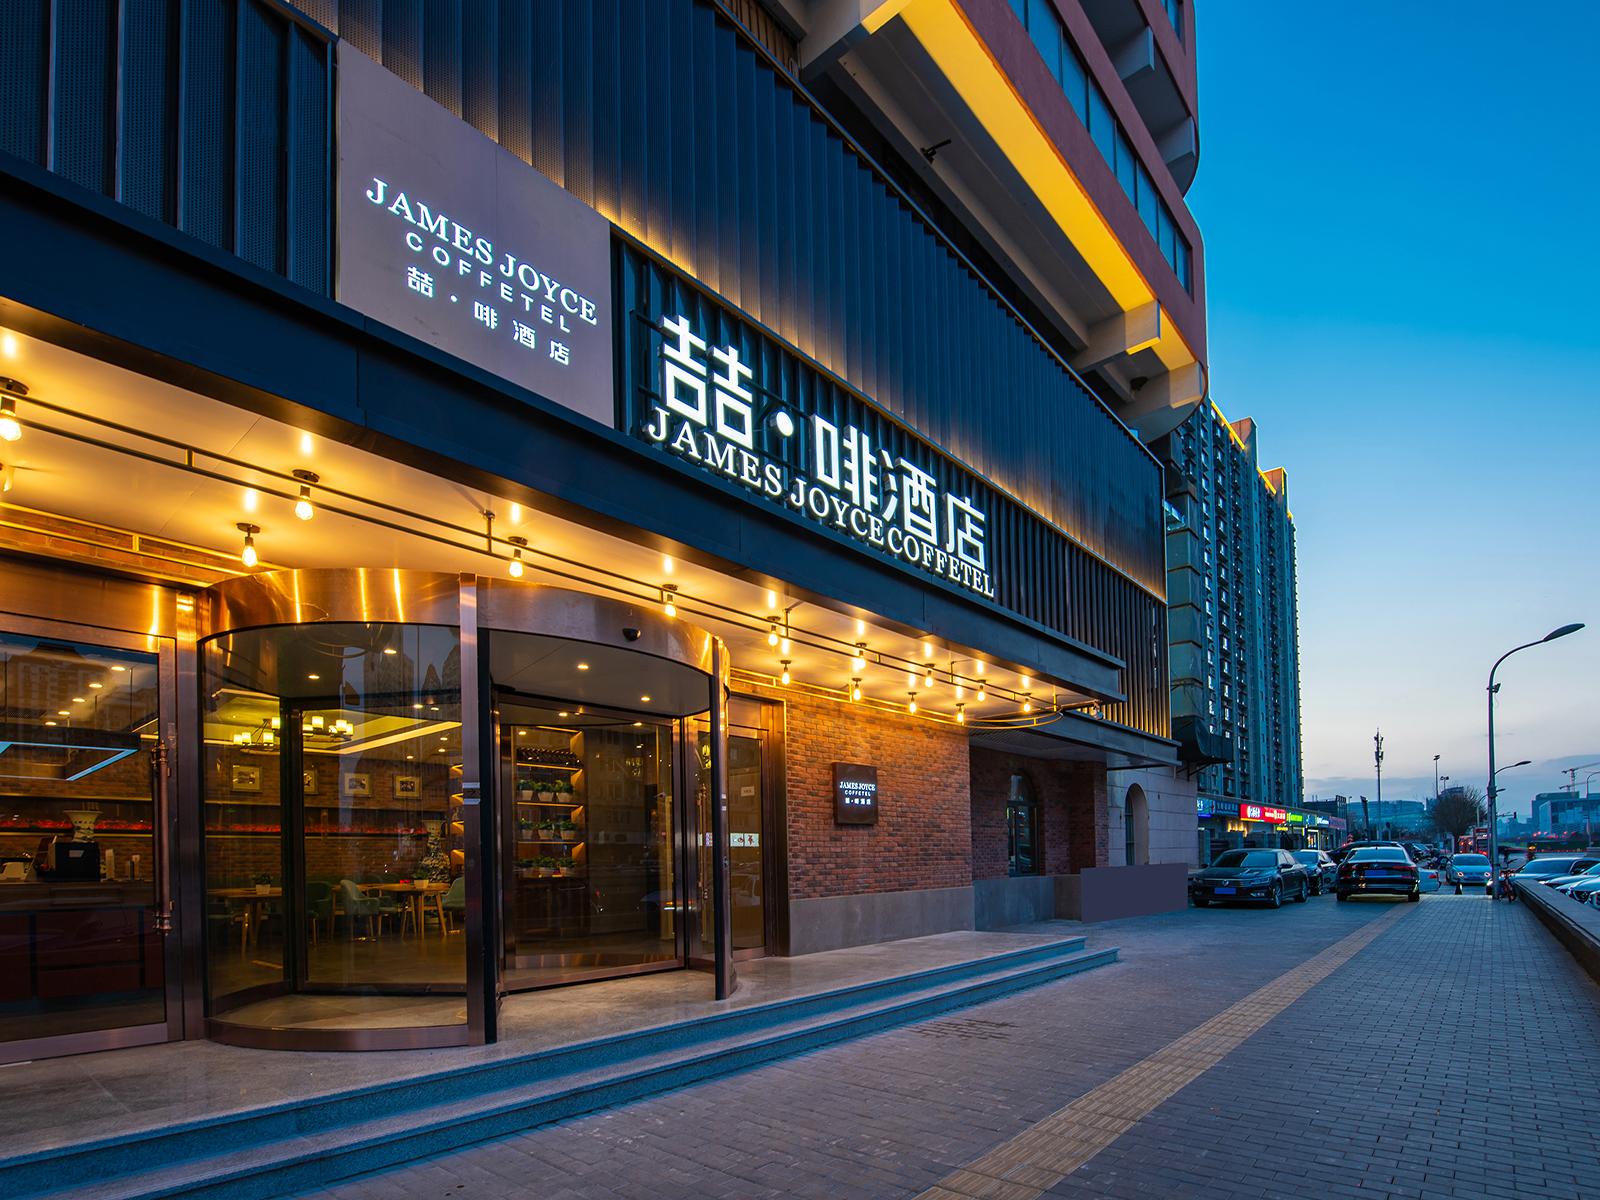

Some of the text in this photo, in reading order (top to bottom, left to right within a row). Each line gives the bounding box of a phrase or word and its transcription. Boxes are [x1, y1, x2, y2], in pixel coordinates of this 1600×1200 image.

[366, 177, 598, 326] JAMES JOYCE
[405, 232, 571, 334] COFFETEL
[648, 406, 995, 599] JAMES JOYCE COFFETEL
[839, 781, 876, 791] JAMES JOYCE
